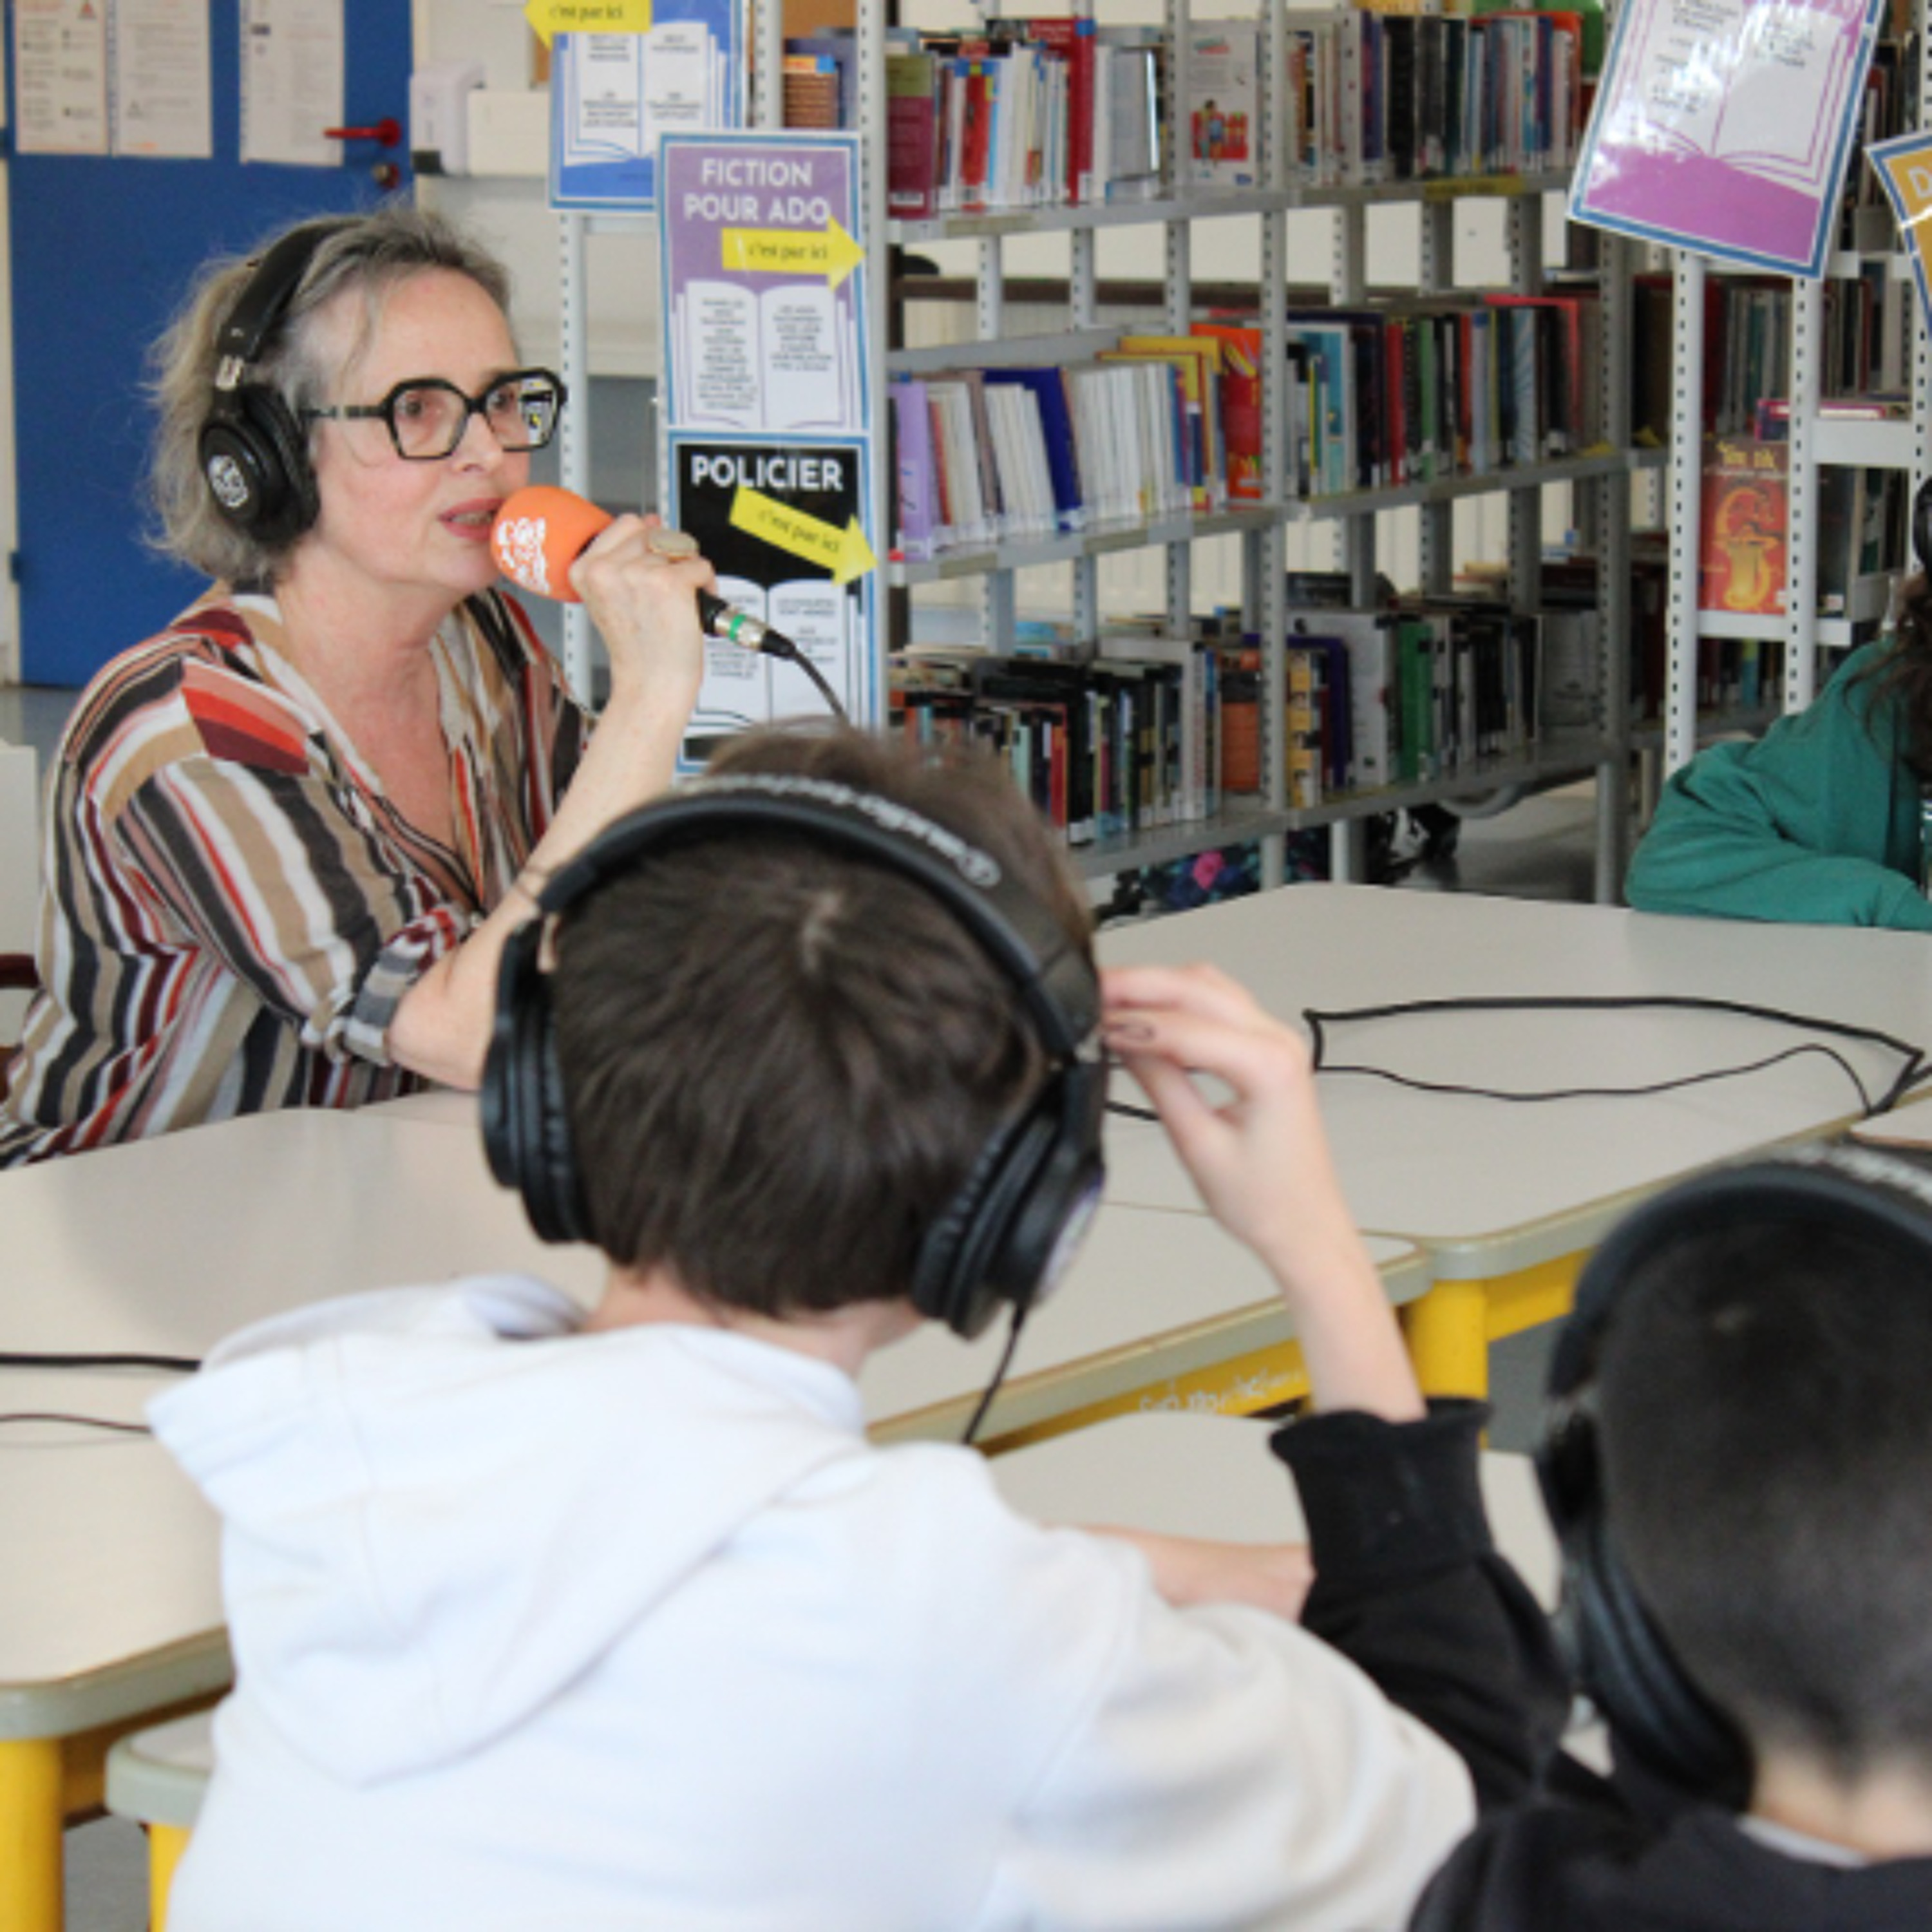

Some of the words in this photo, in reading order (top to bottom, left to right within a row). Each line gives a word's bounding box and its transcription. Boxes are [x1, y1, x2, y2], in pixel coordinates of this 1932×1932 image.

[580, 7, 603, 22] par
[606, 4, 623, 19] ici
[701, 158, 813, 187] FICTION
[683, 194, 759, 222] POUR
[768, 196, 831, 225] ADO
[779, 246, 805, 262] par
[810, 244, 828, 260] ici
[690, 453, 844, 491] POLICIER
